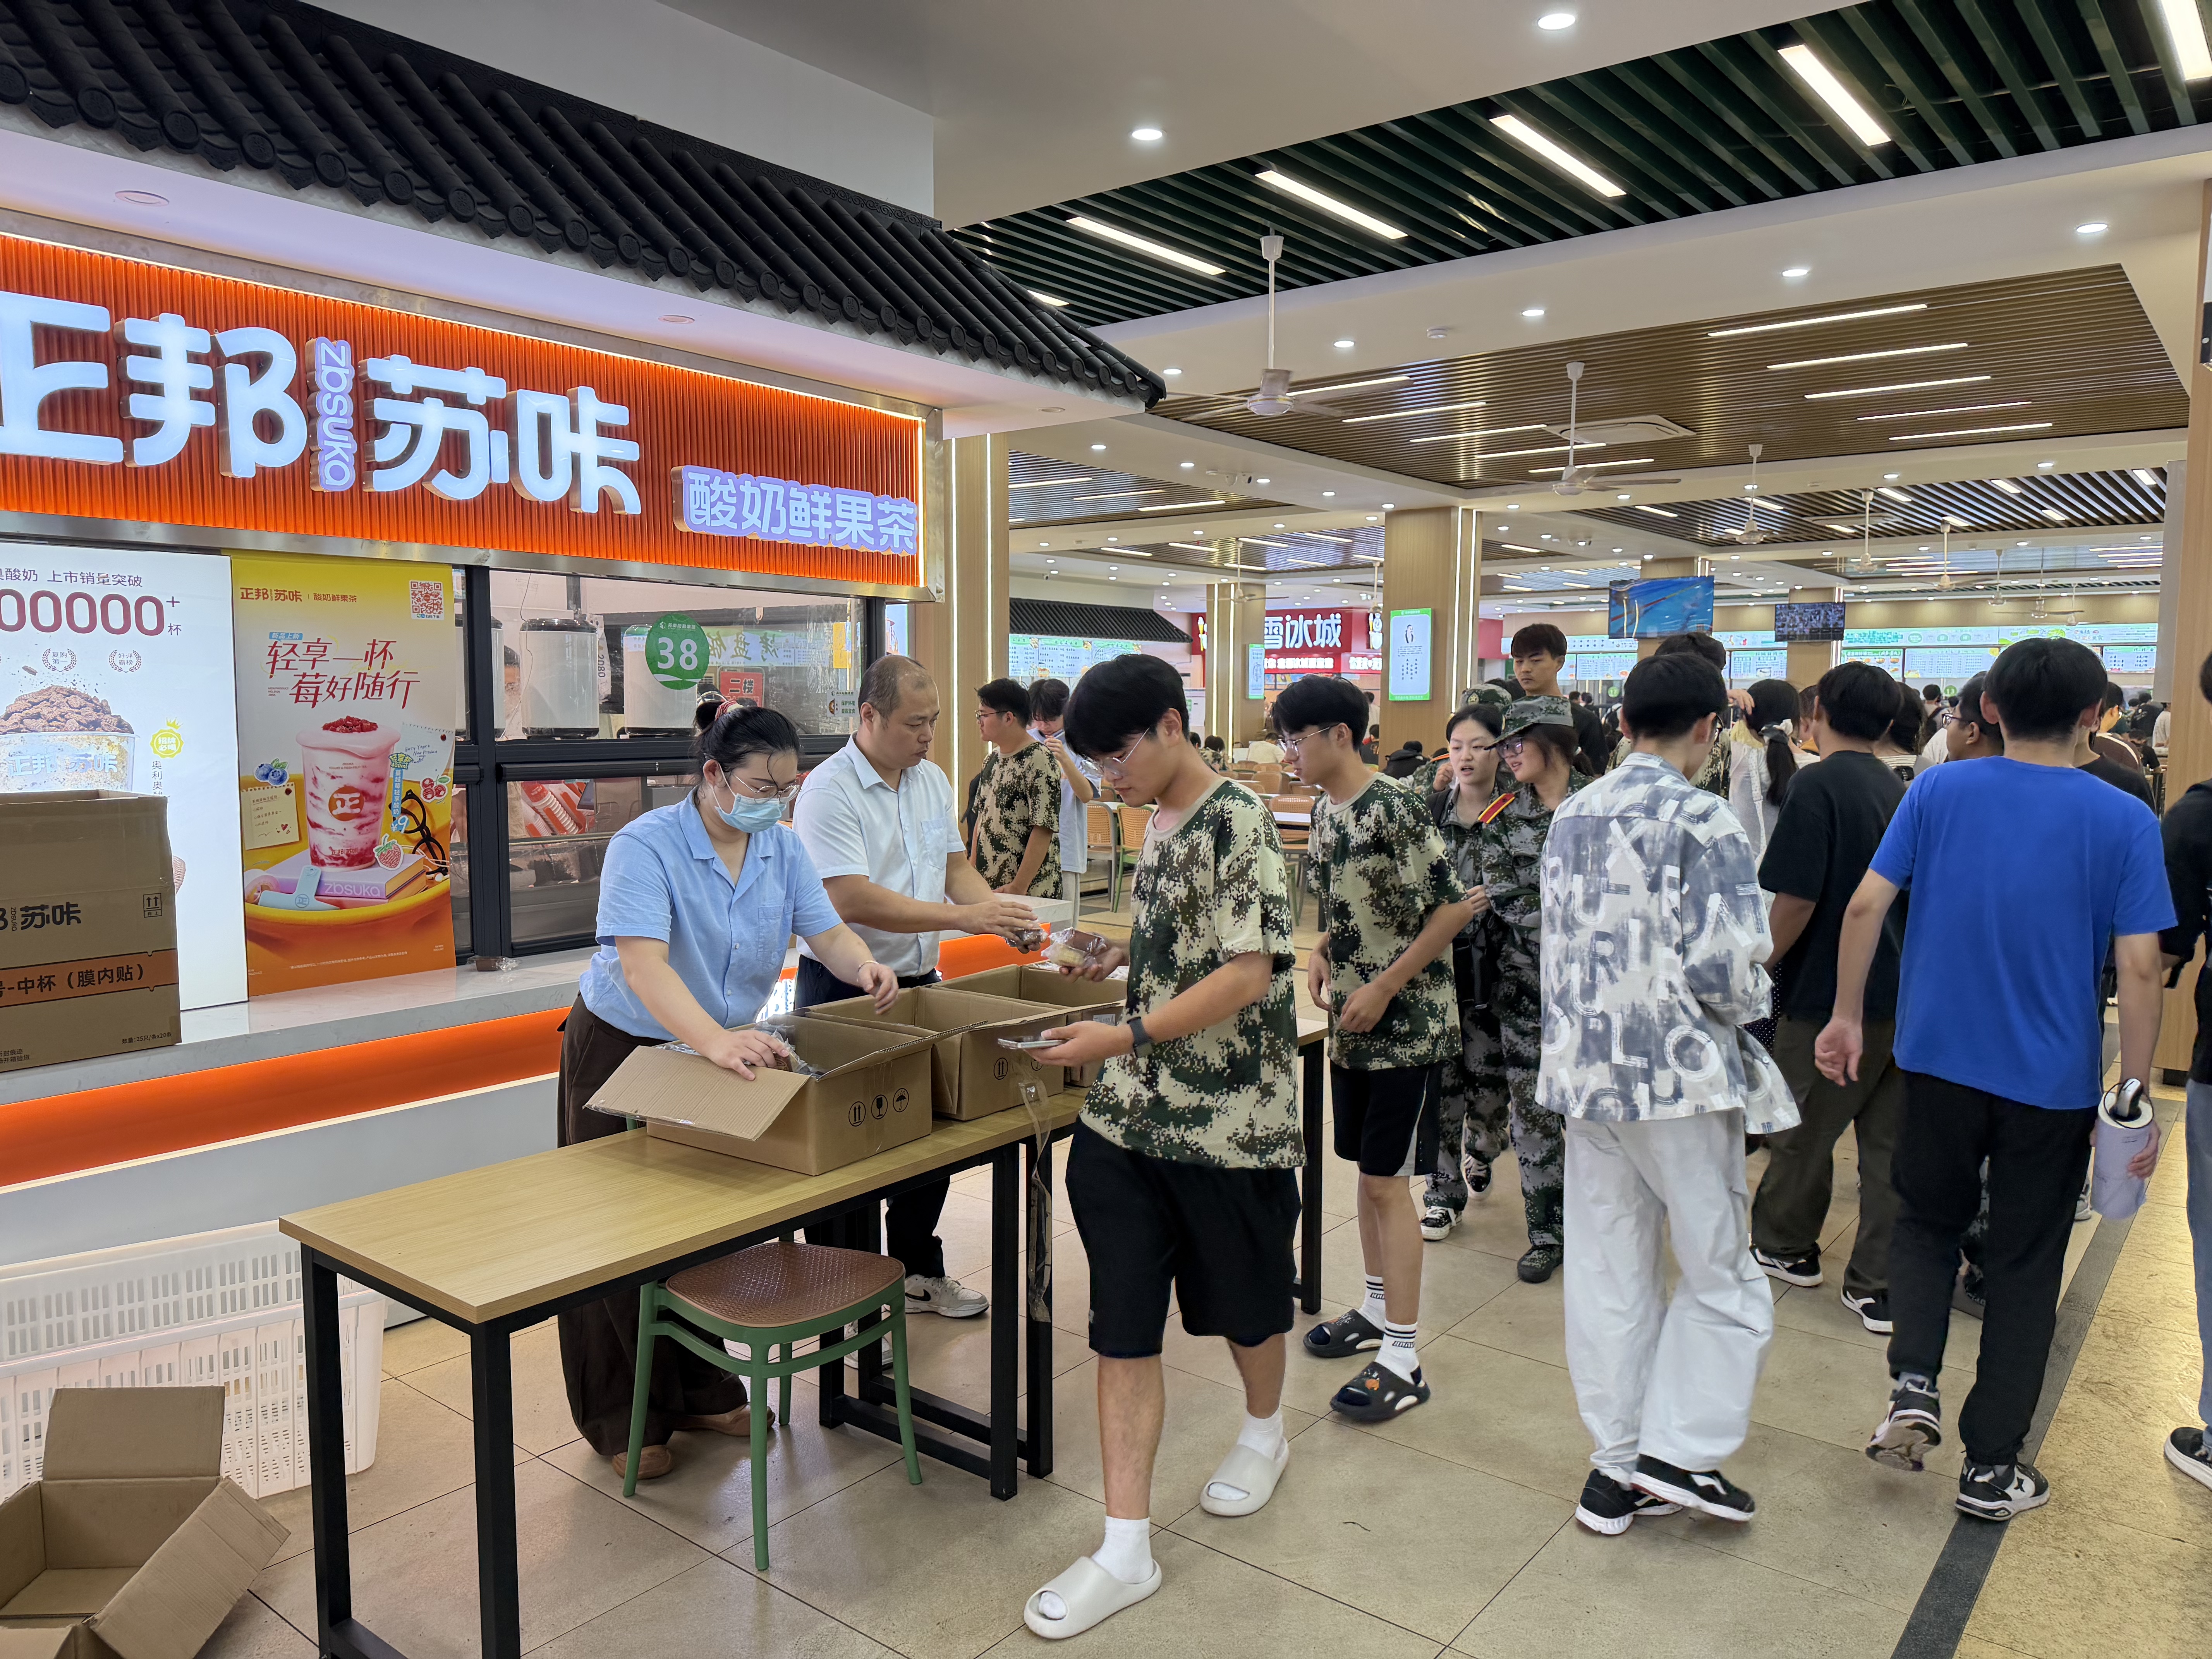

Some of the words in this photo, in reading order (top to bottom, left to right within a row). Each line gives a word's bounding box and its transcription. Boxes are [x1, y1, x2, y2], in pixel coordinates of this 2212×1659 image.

[320, 342, 351, 485] zbsuka
[367, 354, 642, 515] 苏咔
[688, 472, 916, 550] 酸奶鲜果茶
[47, 570, 143, 587] 上市销量突破
[240, 587, 269, 600] 正邦
[274, 589, 302, 602] 苏咔
[313, 593, 357, 603] 酸奶鲜果茶
[168, 623, 182, 635] 杯
[1264, 613, 1341, 649] 雪冰城
[266, 638, 397, 678] 轻享一杯
[657, 637, 698, 670] 38
[289, 670, 420, 709] 莓好随行
[324, 882, 380, 897] zbsuka
[20, 902, 81, 930] 苏咔
